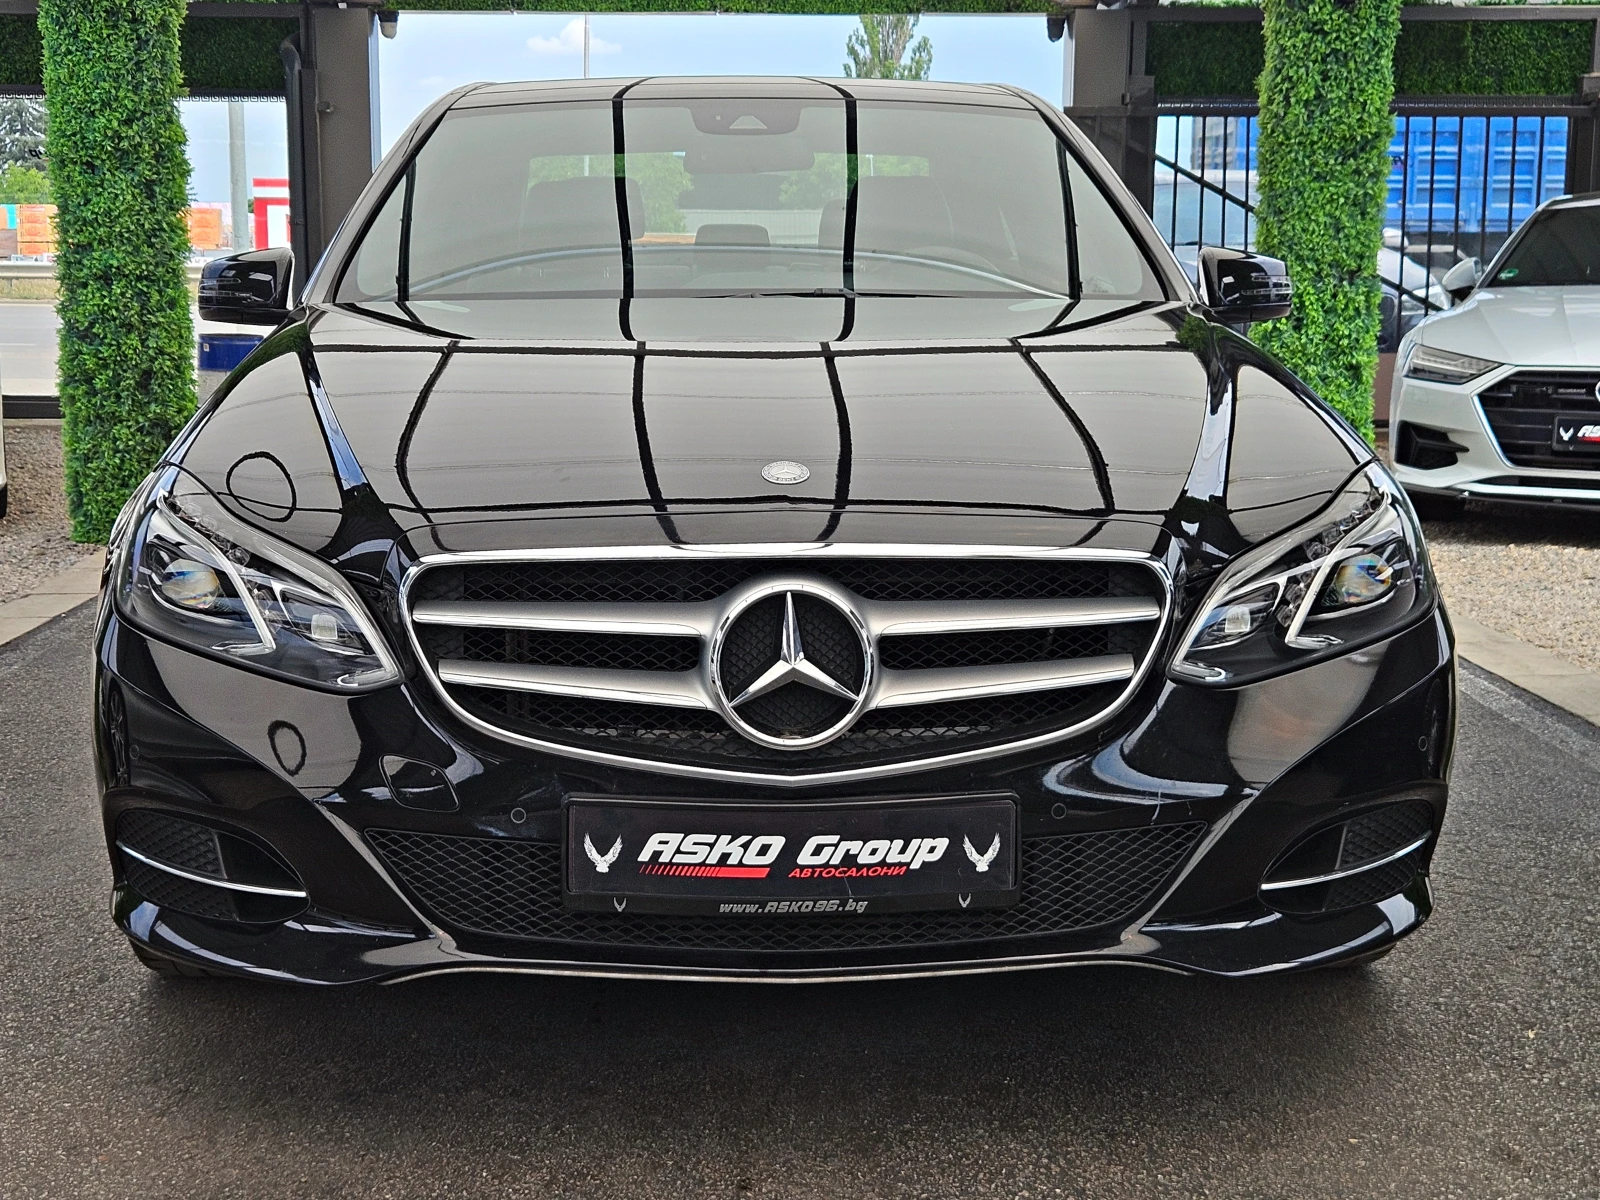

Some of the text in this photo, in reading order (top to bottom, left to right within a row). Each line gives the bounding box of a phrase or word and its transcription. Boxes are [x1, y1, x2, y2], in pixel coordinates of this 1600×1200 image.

[637, 832, 950, 870] ASKO Group
[788, 865, 908, 878] АВТОСАЛОНИ
[718, 898, 869, 914] www.ASKO96.bg
